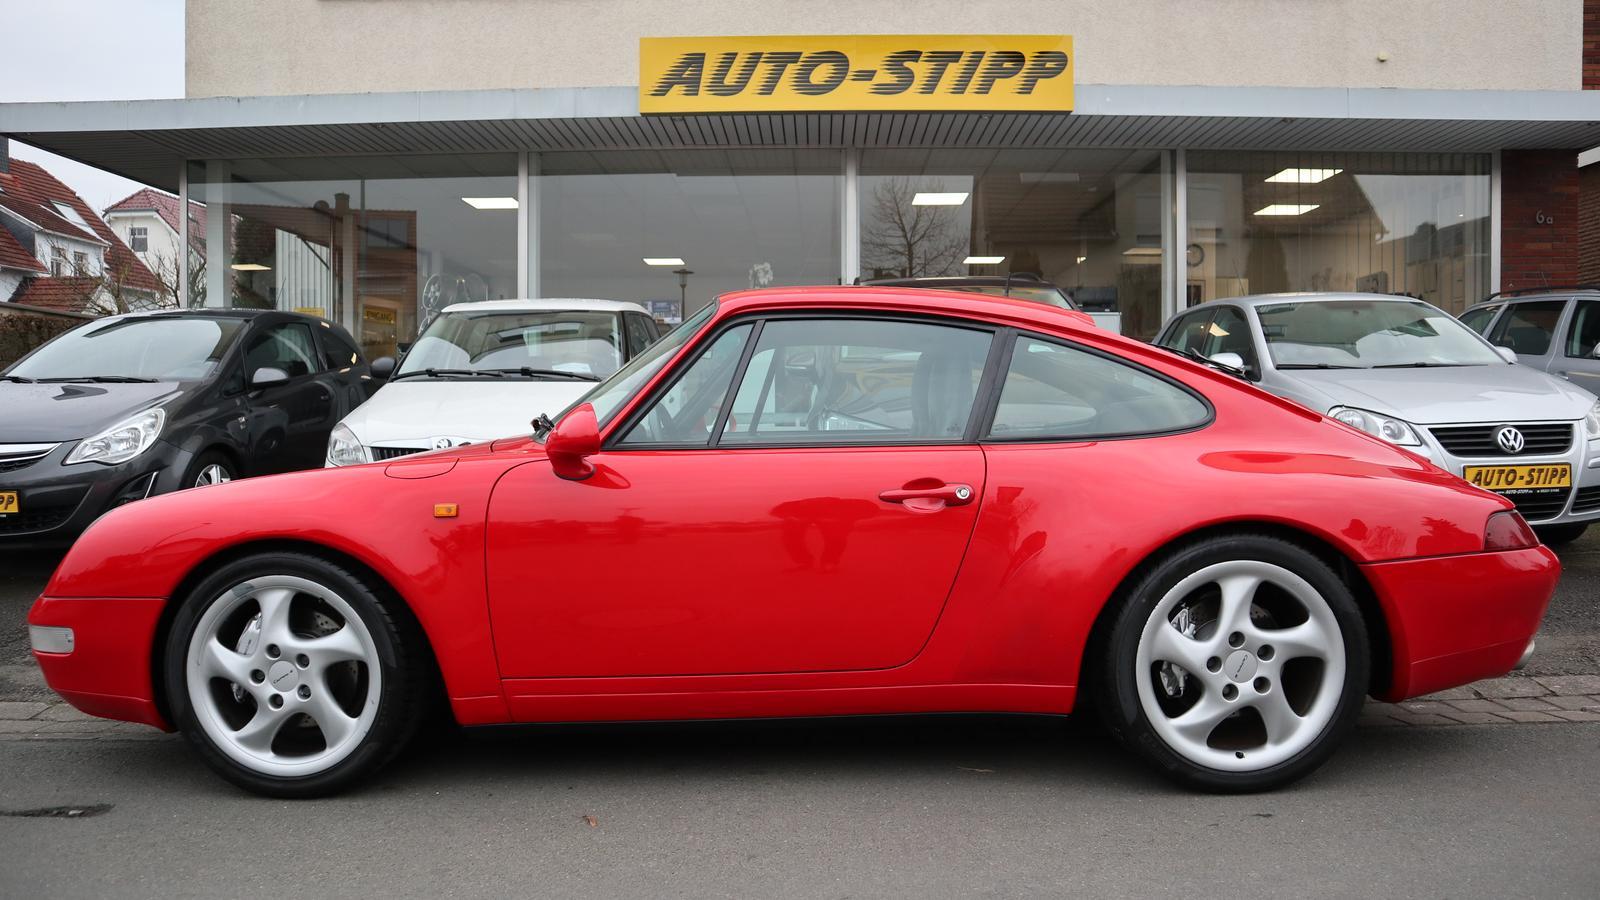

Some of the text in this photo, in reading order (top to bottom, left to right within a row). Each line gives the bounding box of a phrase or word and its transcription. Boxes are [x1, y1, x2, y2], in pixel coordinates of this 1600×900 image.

[643, 50, 1068, 97] AUTO-STIPP
[1536, 209, 1553, 224] 6a
[1472, 467, 1568, 486] AUTO-STIPP
